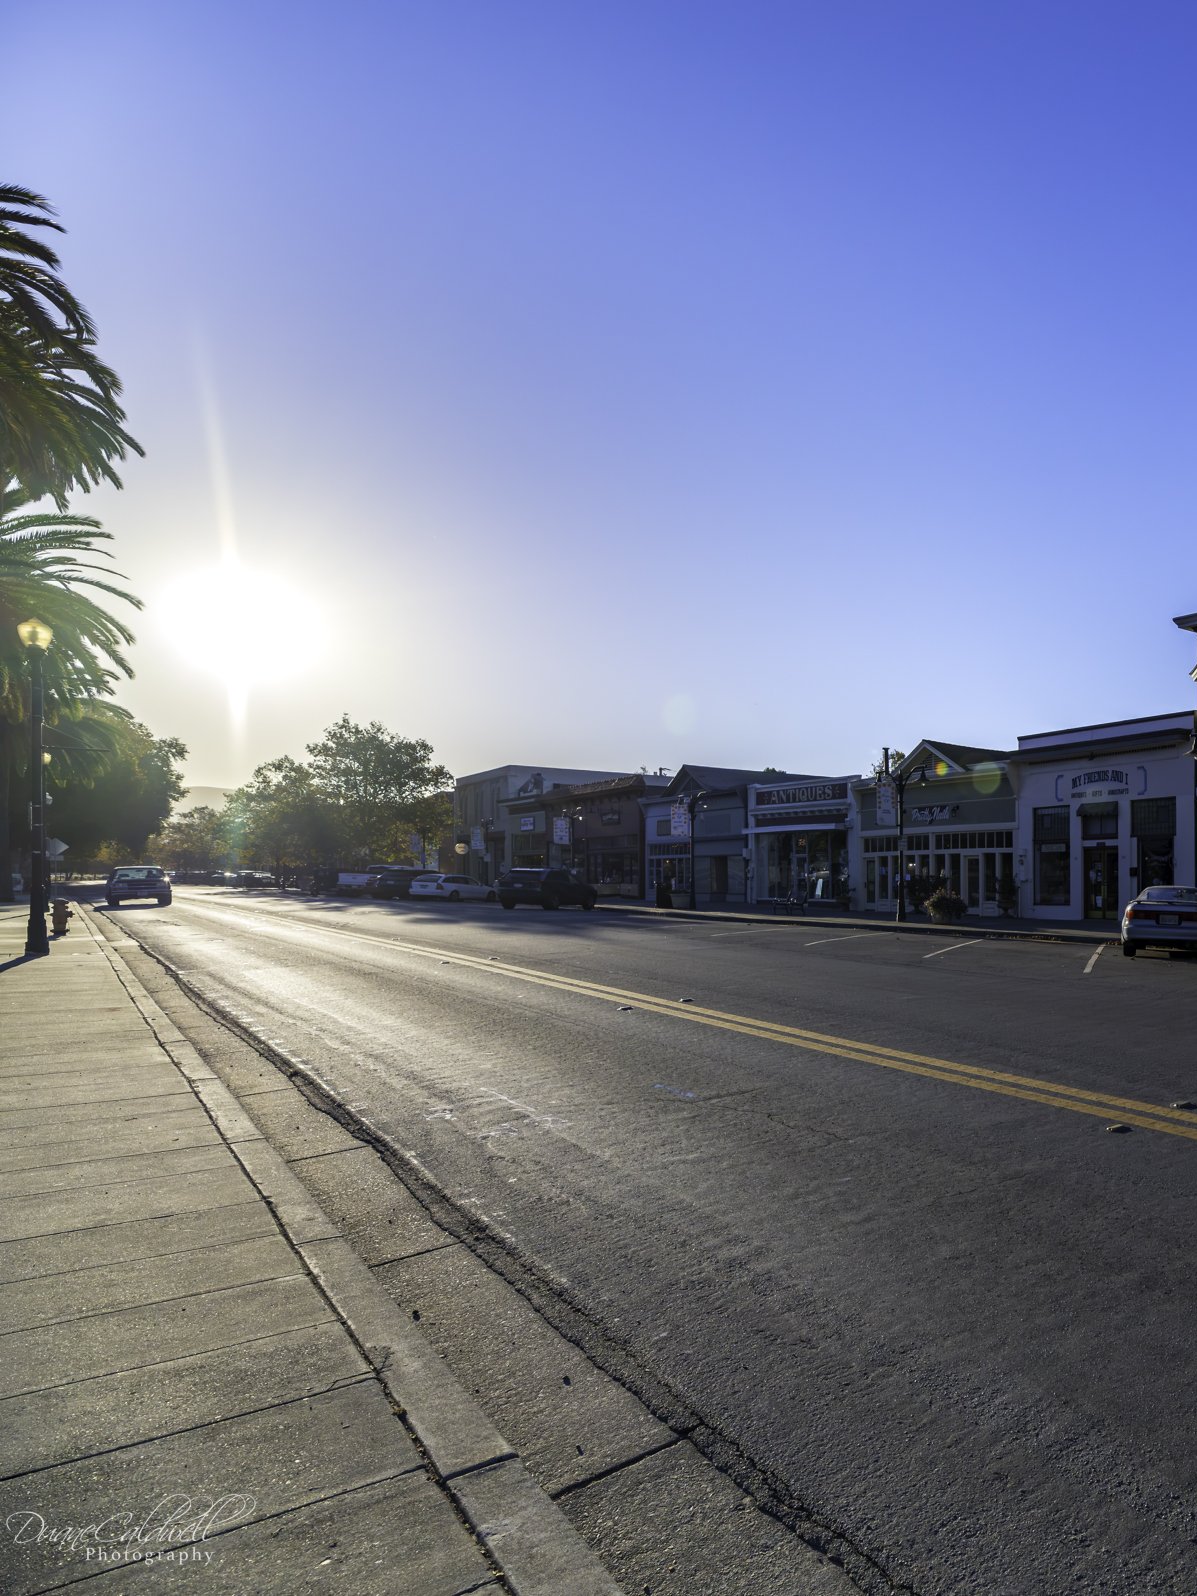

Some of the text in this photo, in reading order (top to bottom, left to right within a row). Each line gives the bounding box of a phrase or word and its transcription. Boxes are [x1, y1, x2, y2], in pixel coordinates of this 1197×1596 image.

[1072, 769, 1129, 789] MY FRIENDS AND I
[770, 785, 832, 804] ANTIQUES
